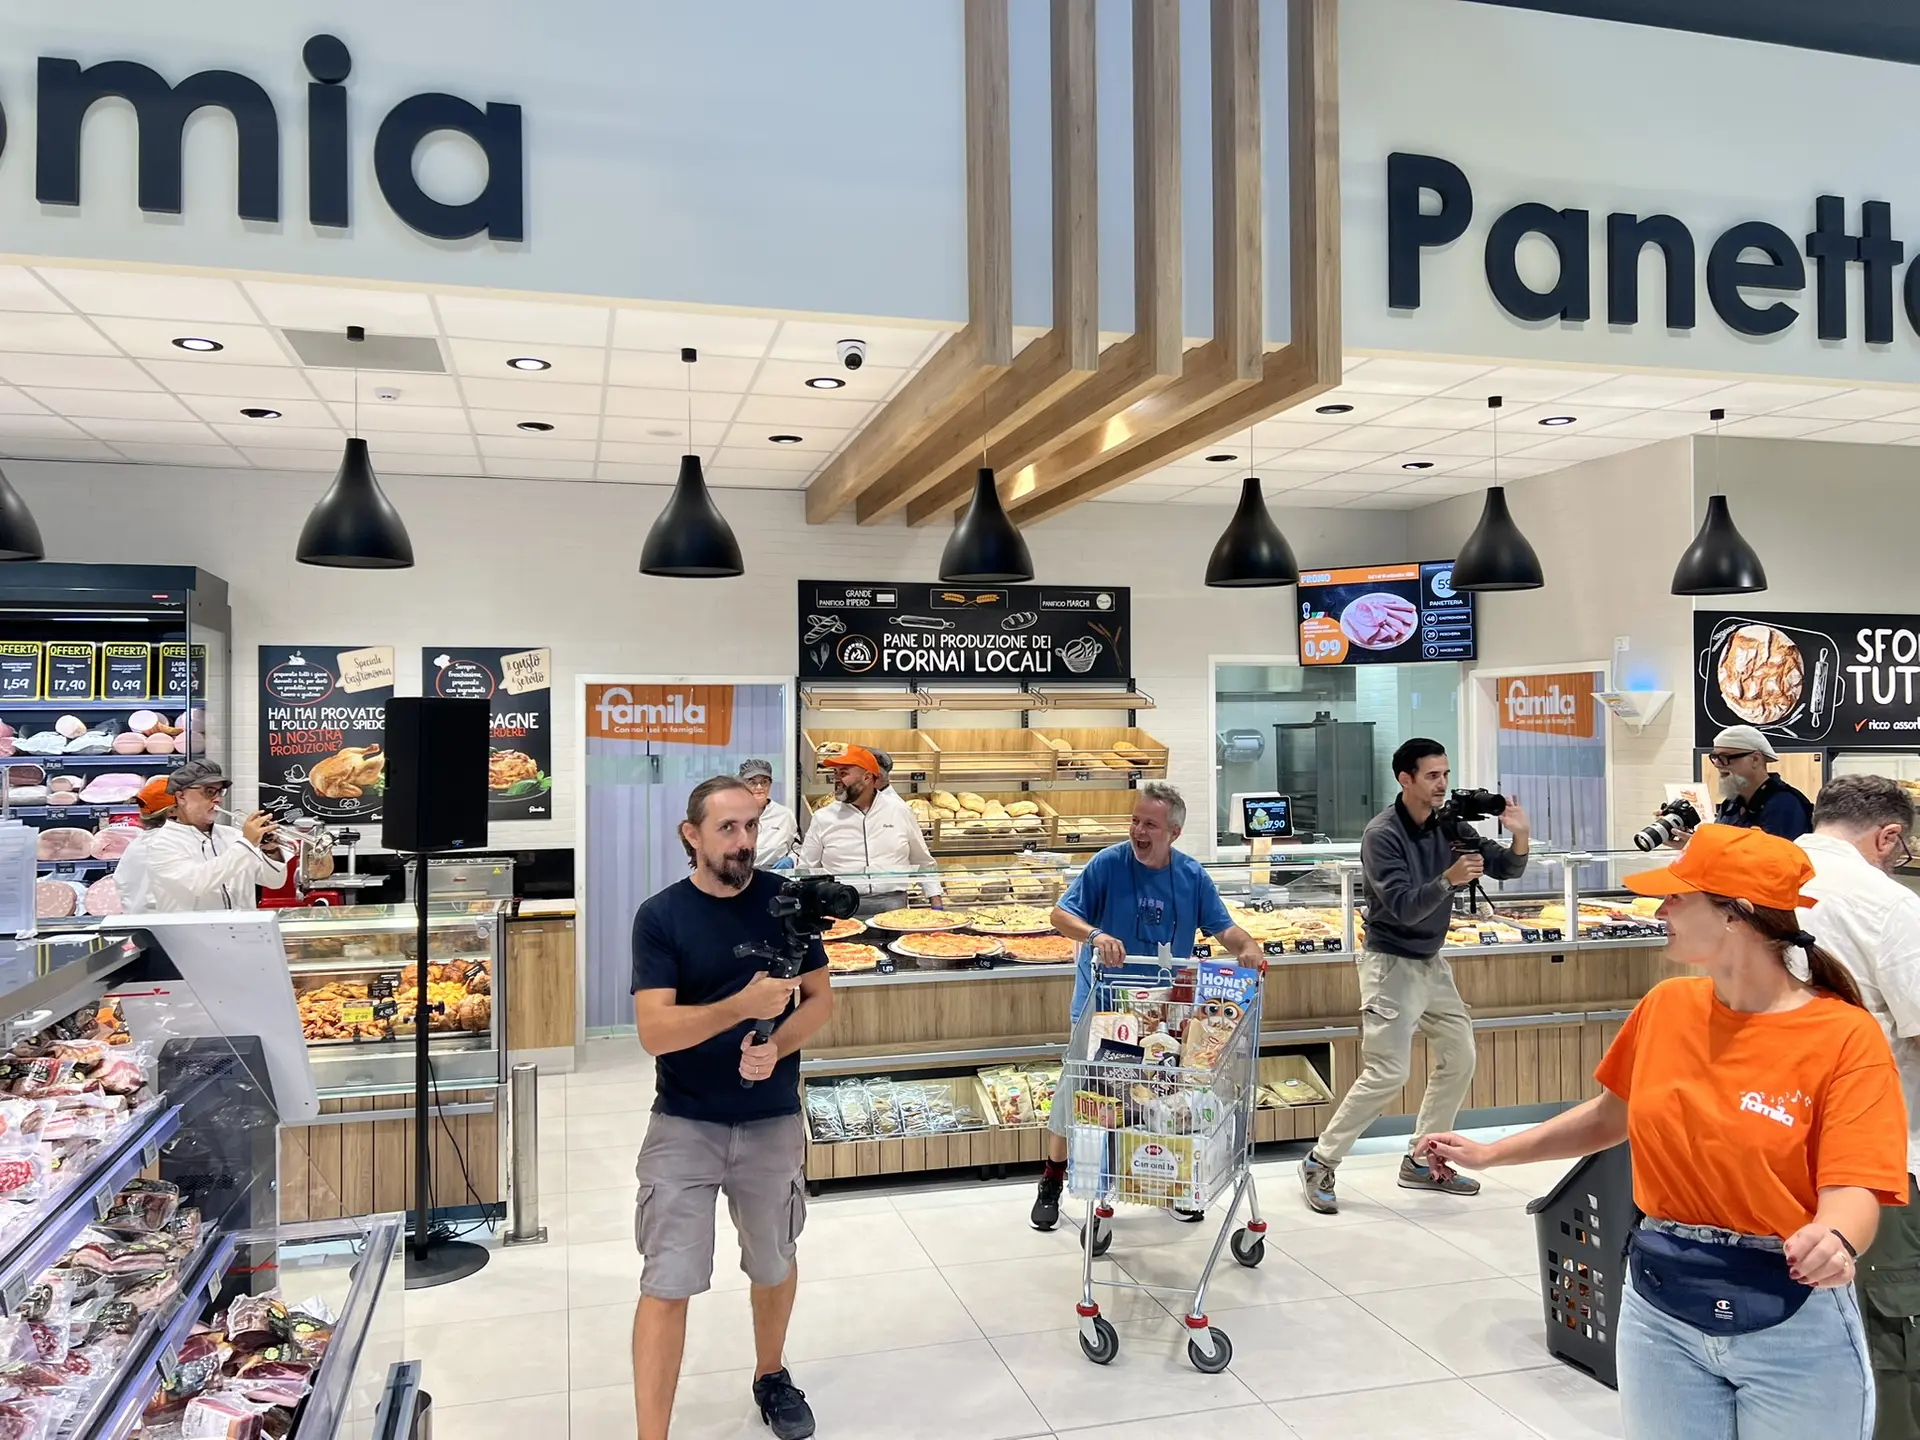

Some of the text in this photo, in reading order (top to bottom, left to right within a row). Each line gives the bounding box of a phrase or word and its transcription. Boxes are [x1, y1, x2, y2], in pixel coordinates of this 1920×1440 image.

[0, 34, 524, 242] mia
[845, 589, 872, 598] GRANDE
[819, 598, 871, 607] PANIFICIO IMPERO
[1066, 599, 1090, 608] MARCHI
[883, 633, 1051, 649] PANE DI PRODUZIONE DEI
[1855, 628, 1920, 663] SFO
[50, 645, 92, 655] OFFERTA
[106, 646, 147, 655] OFFERTA
[1304, 639, 1341, 660] 0,99
[512, 653, 541, 676] gusto
[883, 649, 1051, 672] FORNAI LOCALI
[3, 678, 29, 690] 1,59
[54, 679, 86, 692] 17,90
[112, 679, 141, 692] 0,99
[595, 687, 706, 731] famila
[1504, 680, 1576, 722] famila
[268, 708, 290, 720] HAI
[295, 708, 317, 720] MAI
[269, 721, 279, 730] IL
[281, 720, 318, 730] POLLO
[320, 720, 349, 730] ALLO
[1868, 719, 1891, 730] ricco
[269, 729, 343, 746] DI NOSTRA
[270, 740, 343, 756] PRODUZIONE?
[1202, 972, 1248, 989] HONEY
[1739, 1091, 1795, 1127] famila
